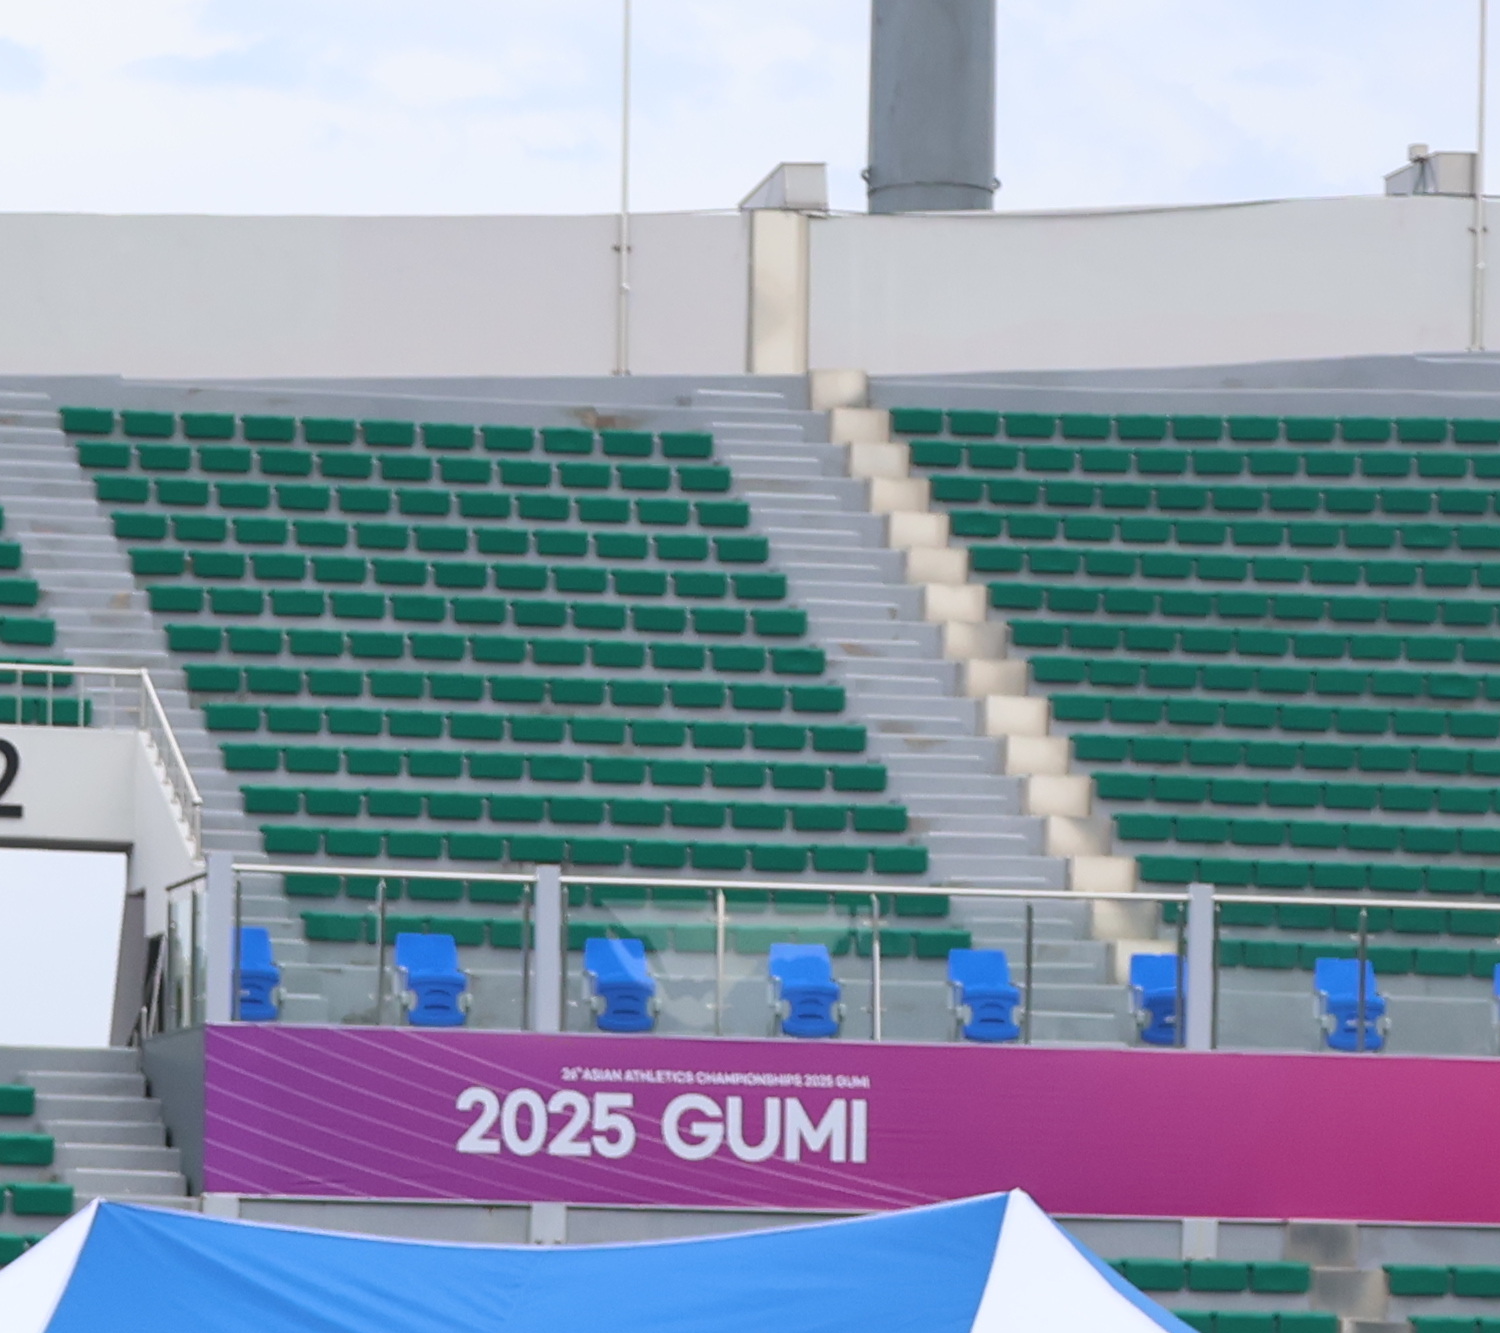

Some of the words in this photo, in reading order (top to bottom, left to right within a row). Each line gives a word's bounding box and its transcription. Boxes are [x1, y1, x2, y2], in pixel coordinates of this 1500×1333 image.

[581, 1067, 623, 1083] ASIAN
[623, 1068, 695, 1084] ATHLETICS
[455, 1086, 637, 1160] 2025
[661, 1092, 869, 1163] GUMI
